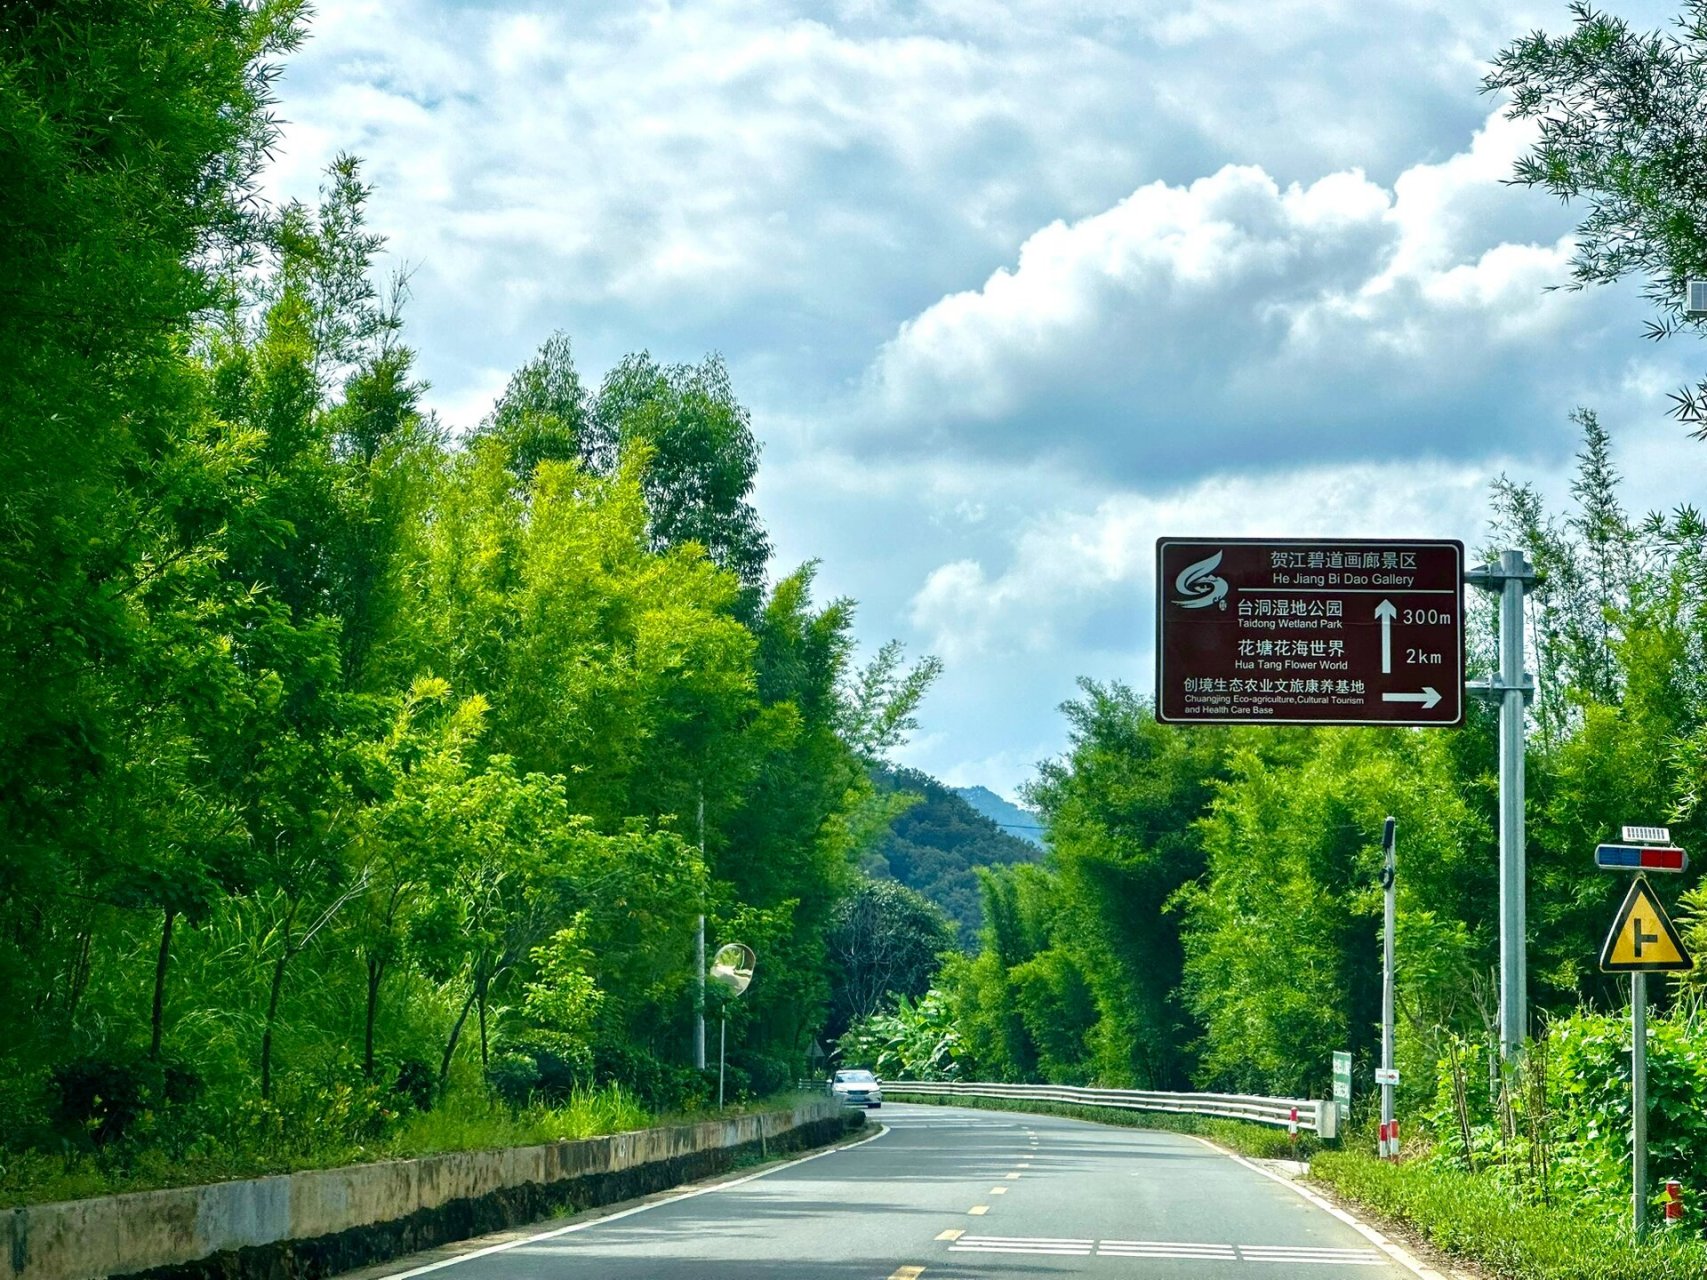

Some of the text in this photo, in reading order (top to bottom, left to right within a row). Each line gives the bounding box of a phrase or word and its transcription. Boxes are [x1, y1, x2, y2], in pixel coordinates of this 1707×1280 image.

[1271, 551, 1417, 570] 贺江碧道画廊景区
[1273, 573, 1414, 587] He Jiang Bi Dao Gallery
[1237, 600, 1343, 617] 台洞湿地公园
[1403, 609, 1451, 625] 300m
[1238, 619, 1343, 630] Taidong Wetland Park
[1237, 640, 1345, 657] 花塘花海世界
[1406, 649, 1442, 664] 2km
[1235, 660, 1348, 672] Hua Tang Flower World
[1185, 695, 1230, 705] Chuangjing
[1332, 696, 1364, 705] Tourism
[1185, 706, 1273, 714] and Health Care Base
